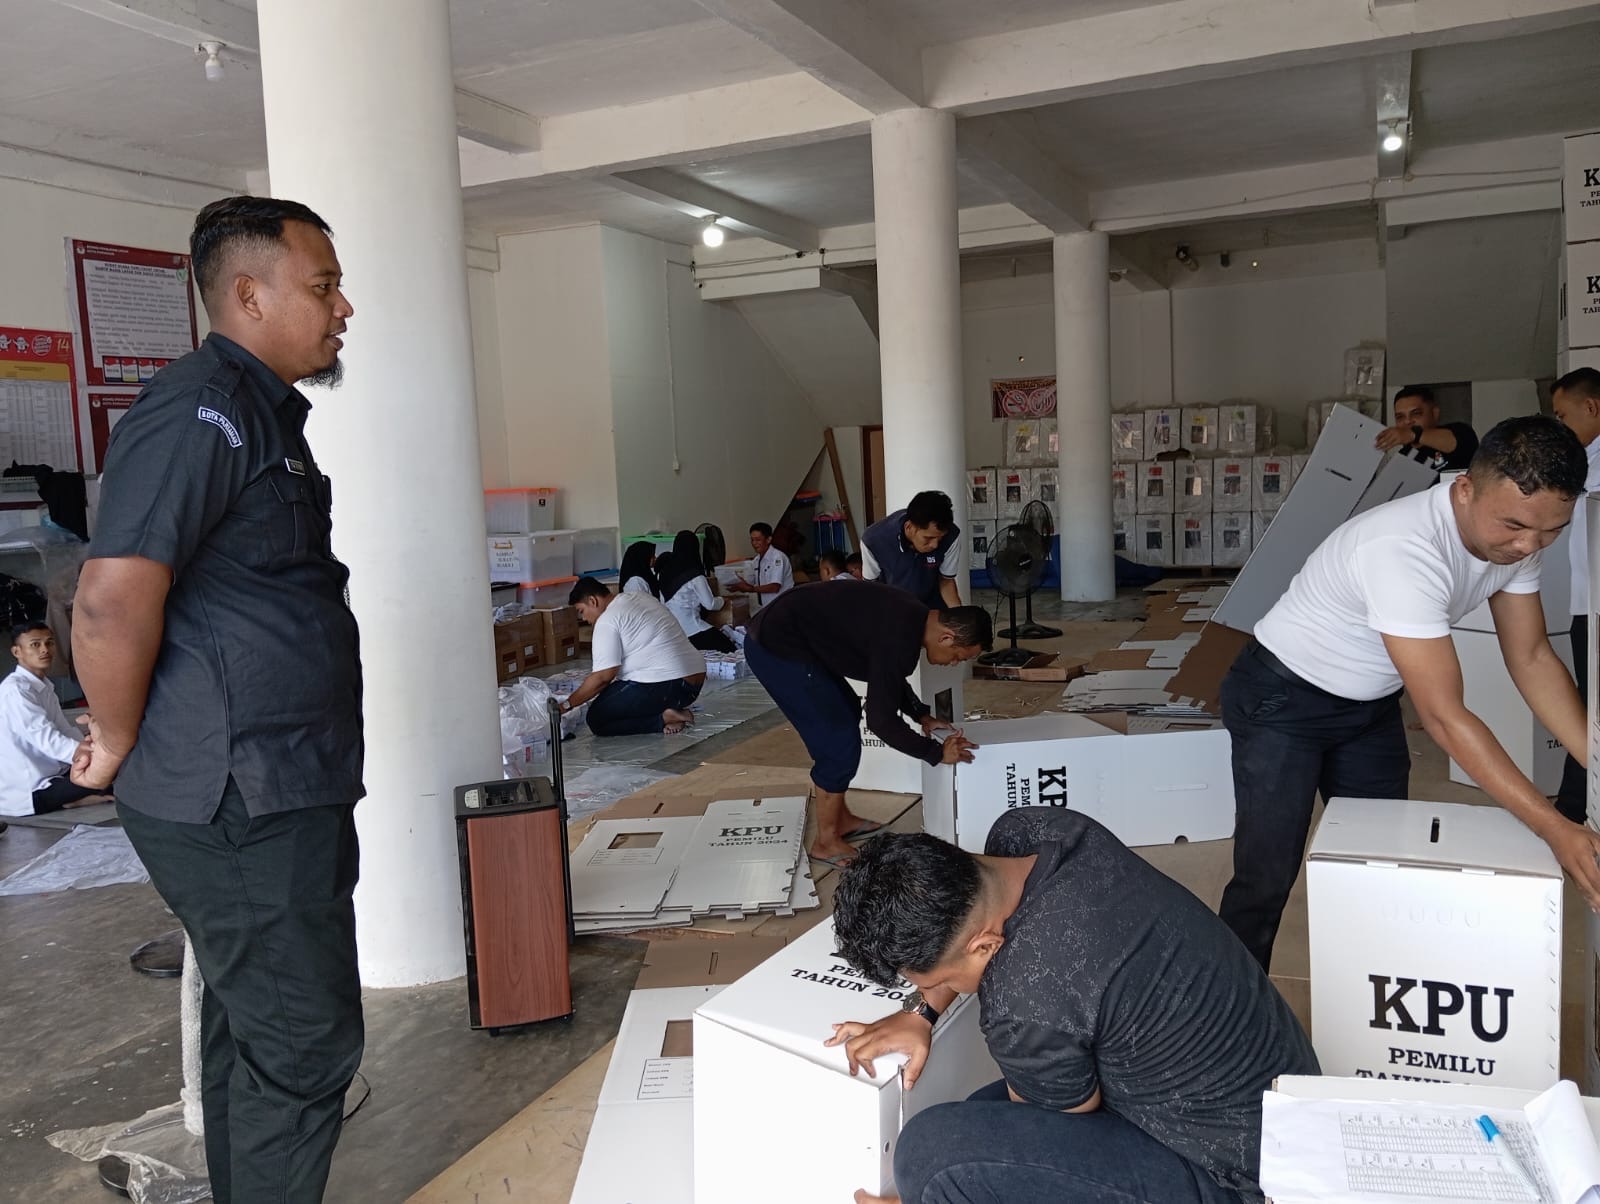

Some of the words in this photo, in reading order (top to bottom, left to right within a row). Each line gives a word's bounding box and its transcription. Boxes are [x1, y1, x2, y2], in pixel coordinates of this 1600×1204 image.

[1580, 199, 1600, 208] TAH
[201, 410, 218, 422] KOTA
[1006, 763, 1017, 808] TAHUN
[1021, 777, 1030, 806] PEM
[1038, 766, 1067, 808] KP
[719, 826, 785, 837] KPU
[791, 968, 870, 992] TAHUN
[1369, 974, 1514, 1043] KPU
[1388, 1047, 1496, 1076] PEMILU
